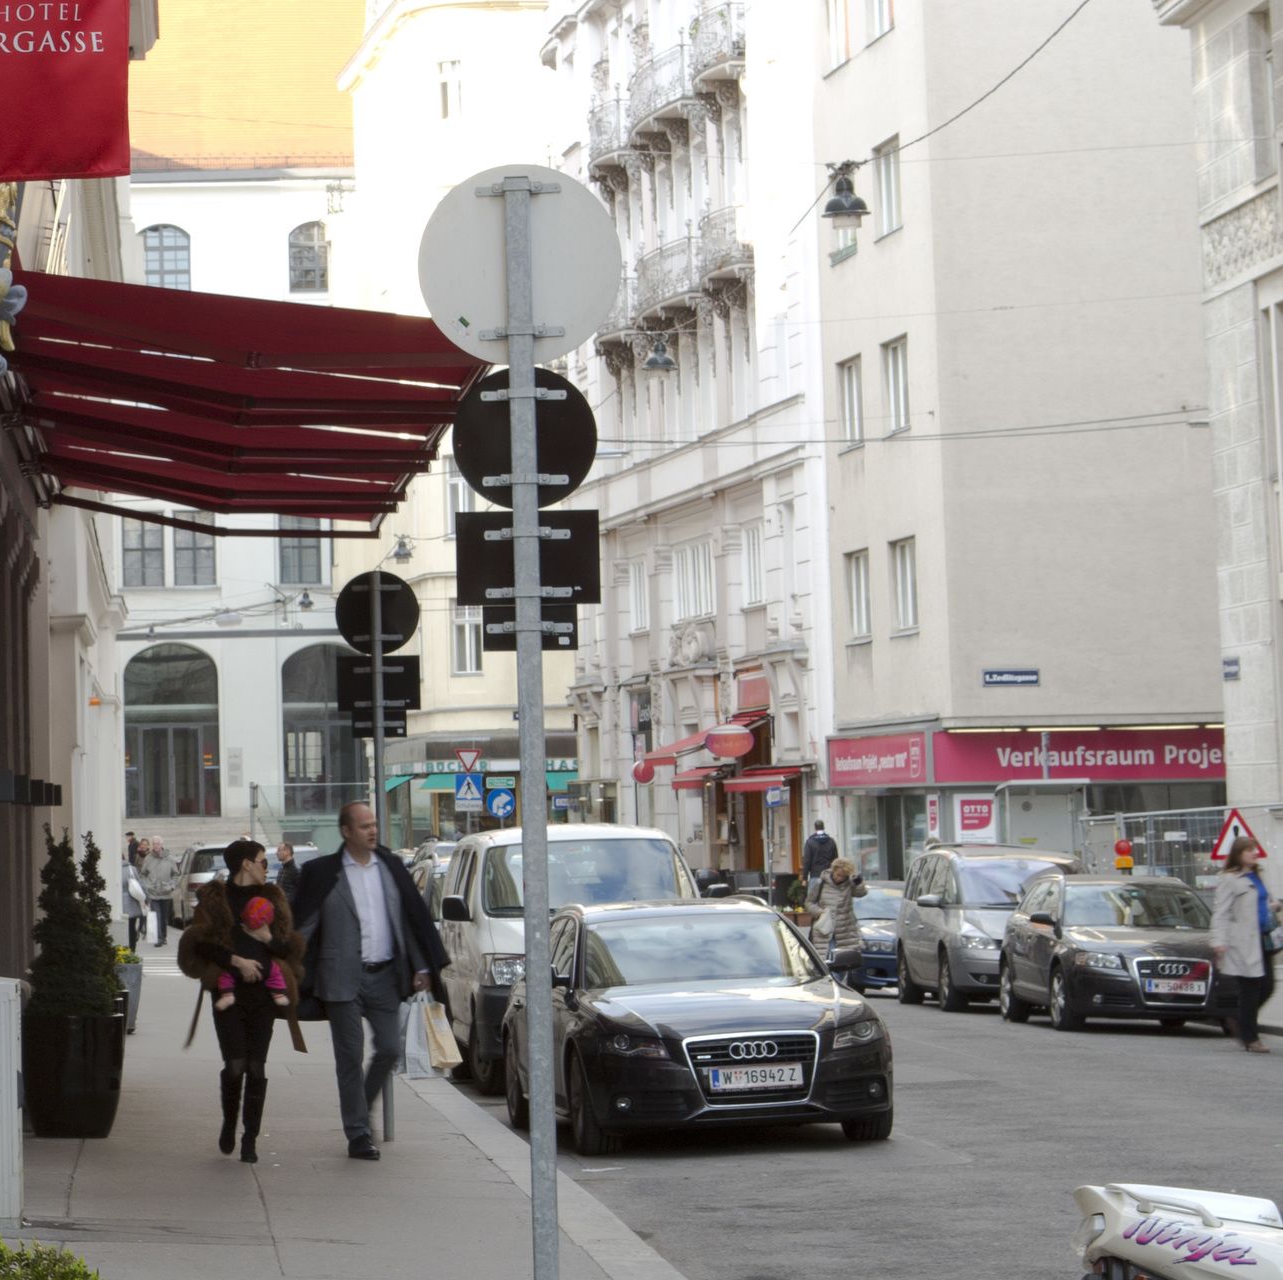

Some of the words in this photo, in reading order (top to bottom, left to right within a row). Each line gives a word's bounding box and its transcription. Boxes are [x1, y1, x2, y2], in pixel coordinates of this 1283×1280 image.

[996, 746, 1155, 768] Verkaufsraum
[1165, 743, 1226, 769] Proje
[963, 804, 989, 813] OTTO
[722, 1071, 733, 1085] W
[744, 1068, 785, 1084] 16942
[788, 1067, 797, 1081] Z
[1123, 1217, 1258, 1266] Ninja
